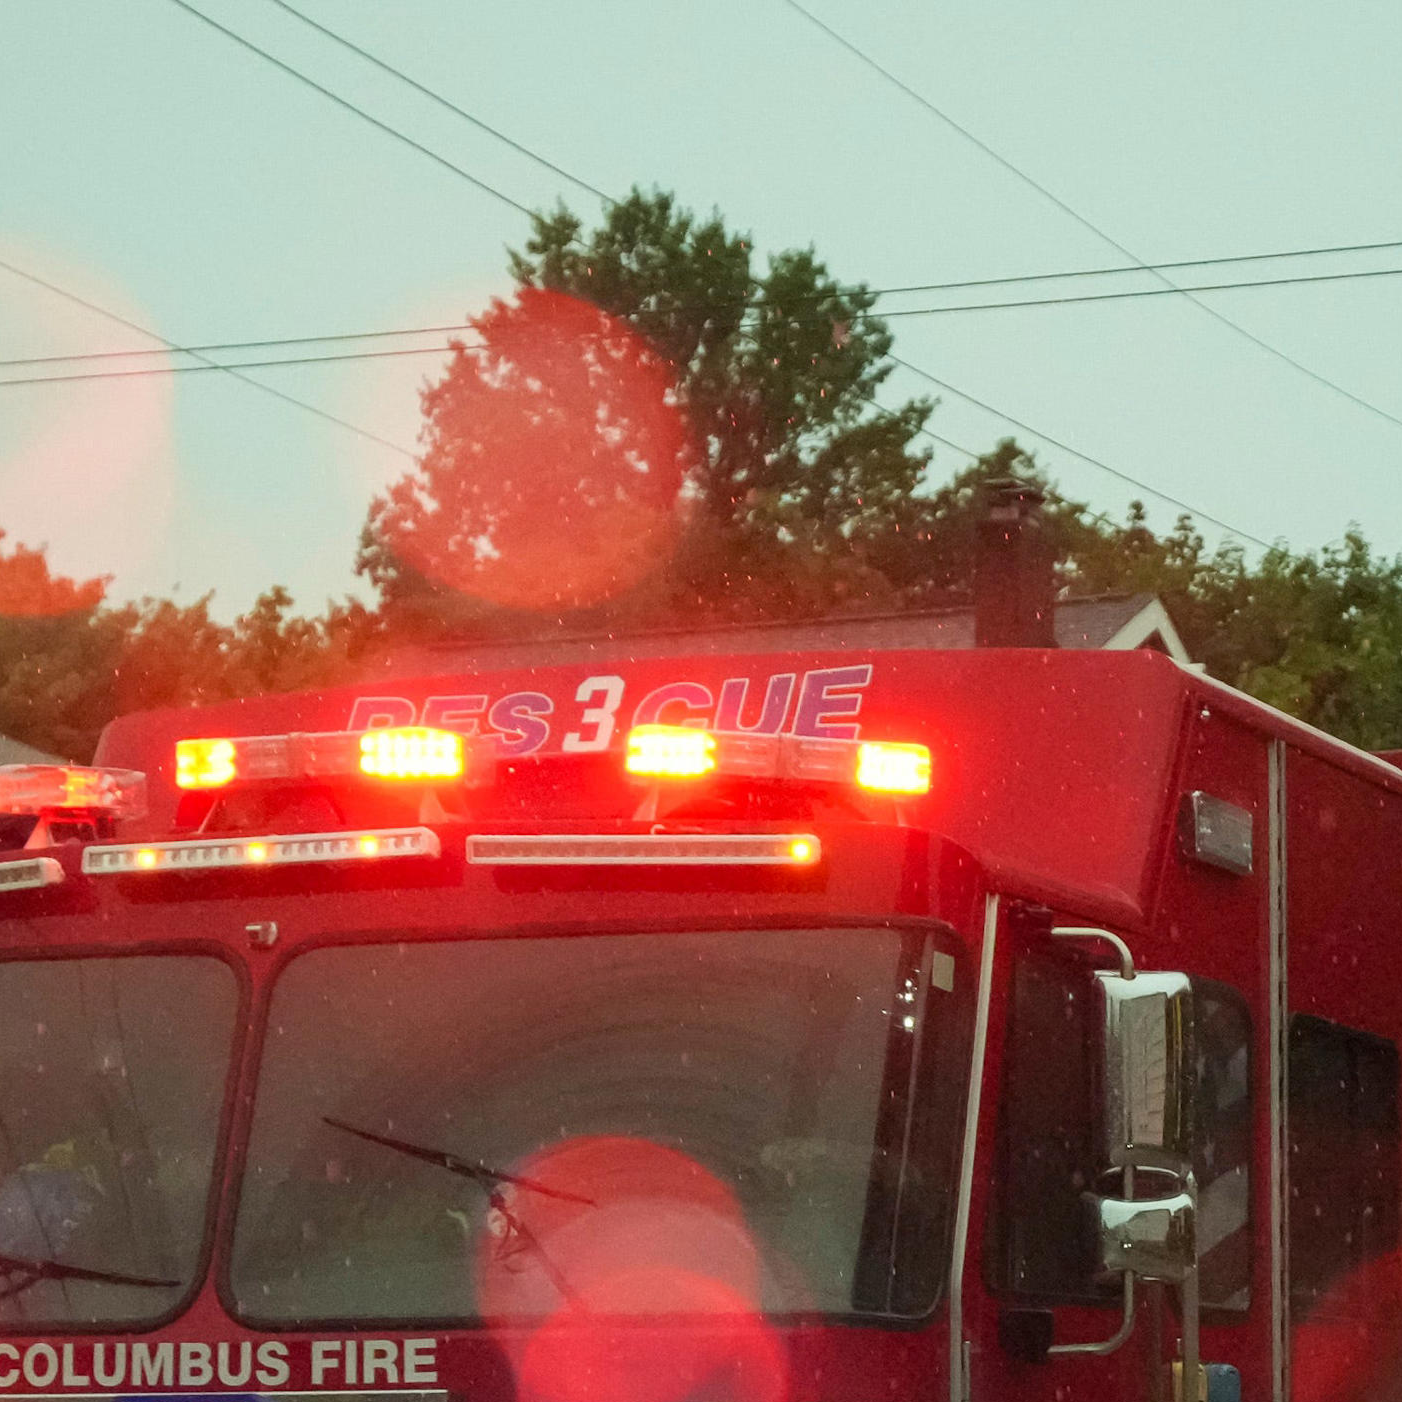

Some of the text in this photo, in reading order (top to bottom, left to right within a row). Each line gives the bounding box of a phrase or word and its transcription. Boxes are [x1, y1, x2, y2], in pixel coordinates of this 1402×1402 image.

[562, 674, 626, 753] 3
[631, 663, 874, 741] CUE
[310, 1338, 438, 1384] FIRE
